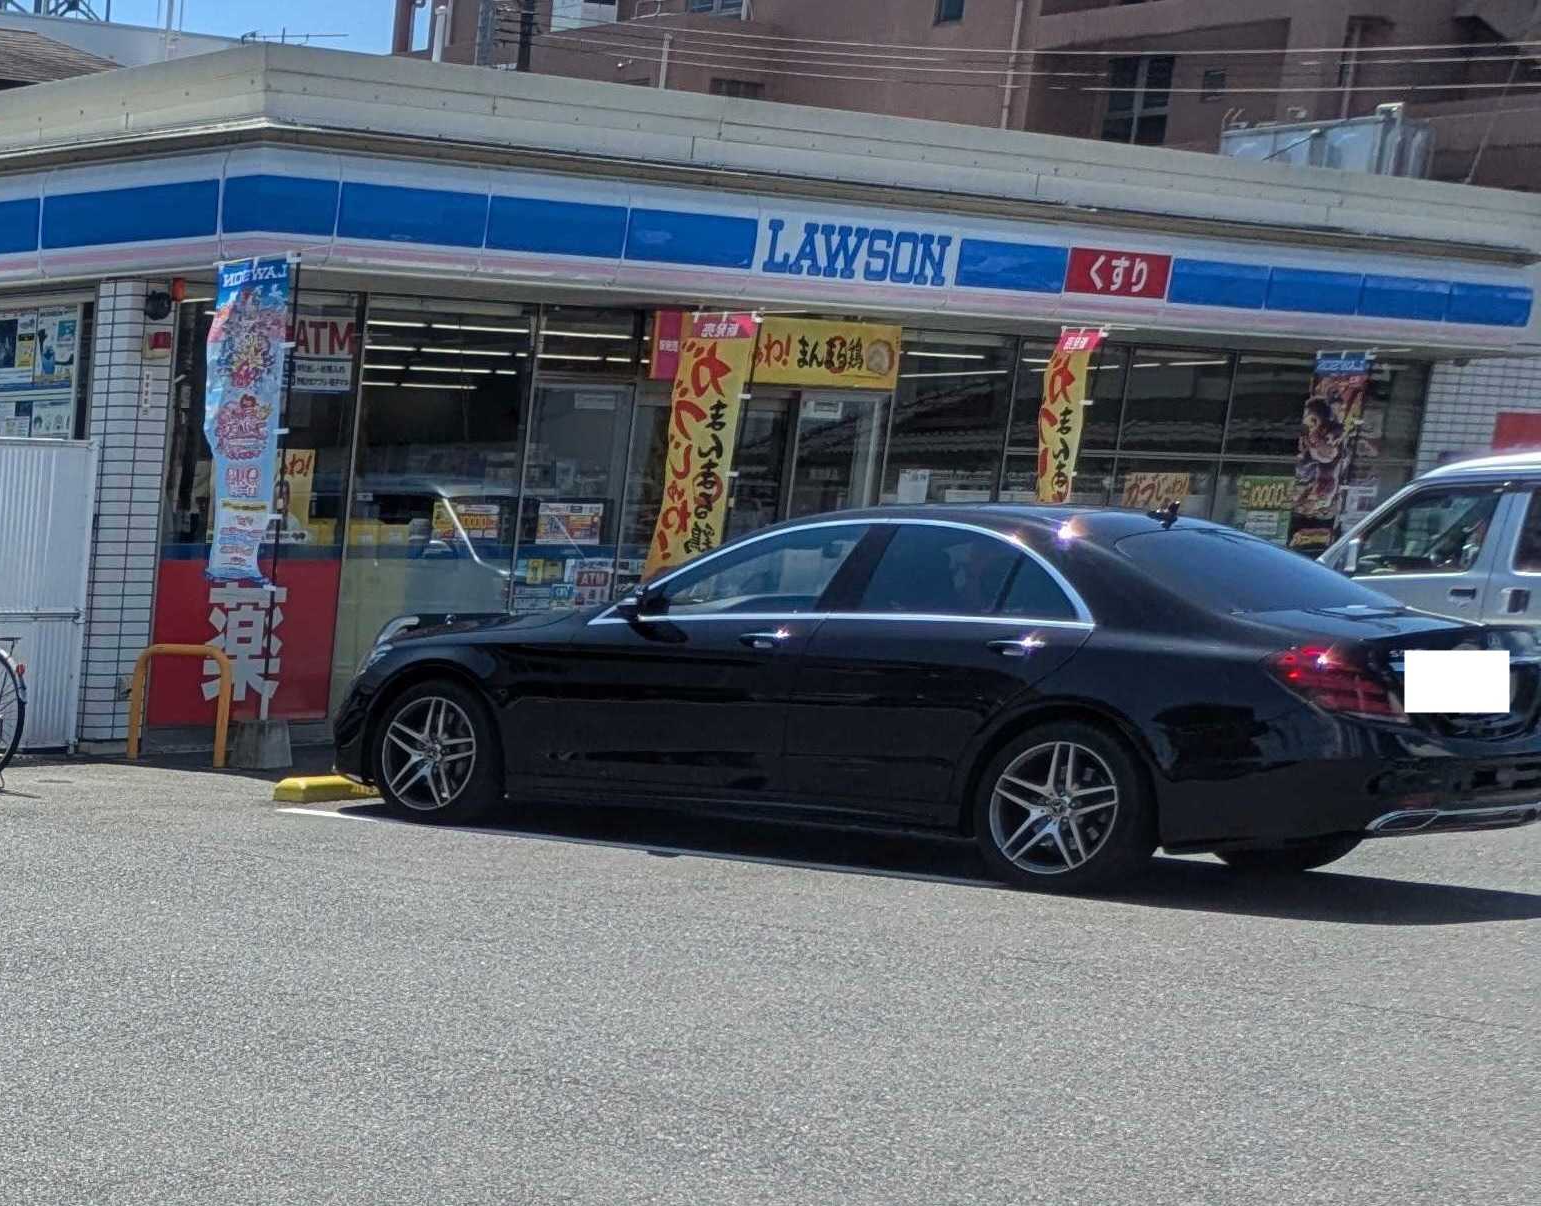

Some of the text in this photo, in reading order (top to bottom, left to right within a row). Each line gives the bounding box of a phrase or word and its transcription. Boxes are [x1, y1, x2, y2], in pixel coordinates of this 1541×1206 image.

[762, 219, 952, 286] LAWSON
[1088, 254, 1148, 292] くすり
[296, 320, 357, 354] ATM
[201, 582, 288, 701] 薬
